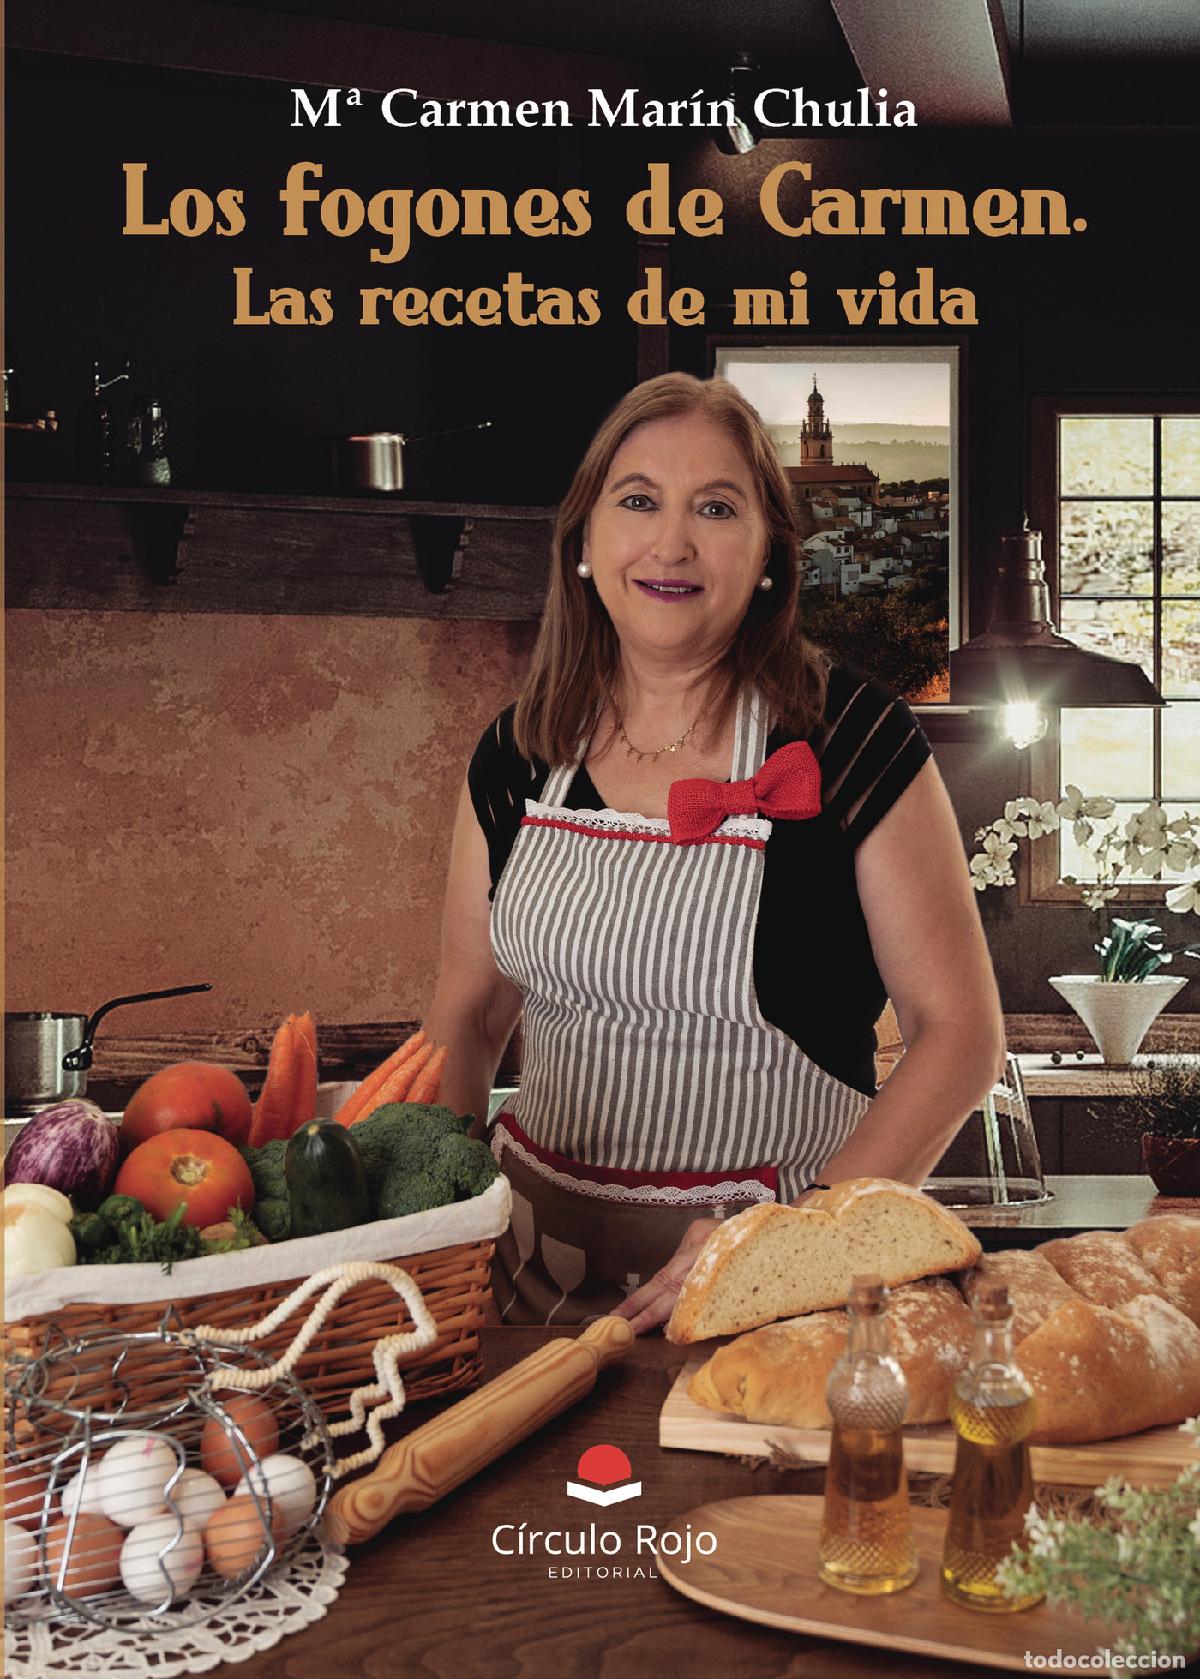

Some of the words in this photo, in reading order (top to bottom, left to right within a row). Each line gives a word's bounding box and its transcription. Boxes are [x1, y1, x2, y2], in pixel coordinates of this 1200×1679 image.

[381, 88, 573, 128] Carmen
[587, 87, 740, 128] Marín
[754, 87, 918, 128] Chulia
[122, 163, 246, 238] Los
[279, 162, 592, 264] fogones
[626, 163, 725, 238] de
[758, 162, 1088, 238] Carmen.
[233, 267, 334, 326] Las
[360, 270, 600, 327] recetas
[627, 267, 705, 327] de
[733, 270, 810, 326] mi
[837, 267, 979, 326] vida
[491, 1522, 622, 1556] Círculo
[636, 1523, 718, 1564] Rojo
[548, 1566, 658, 1579] EDITORIAL
